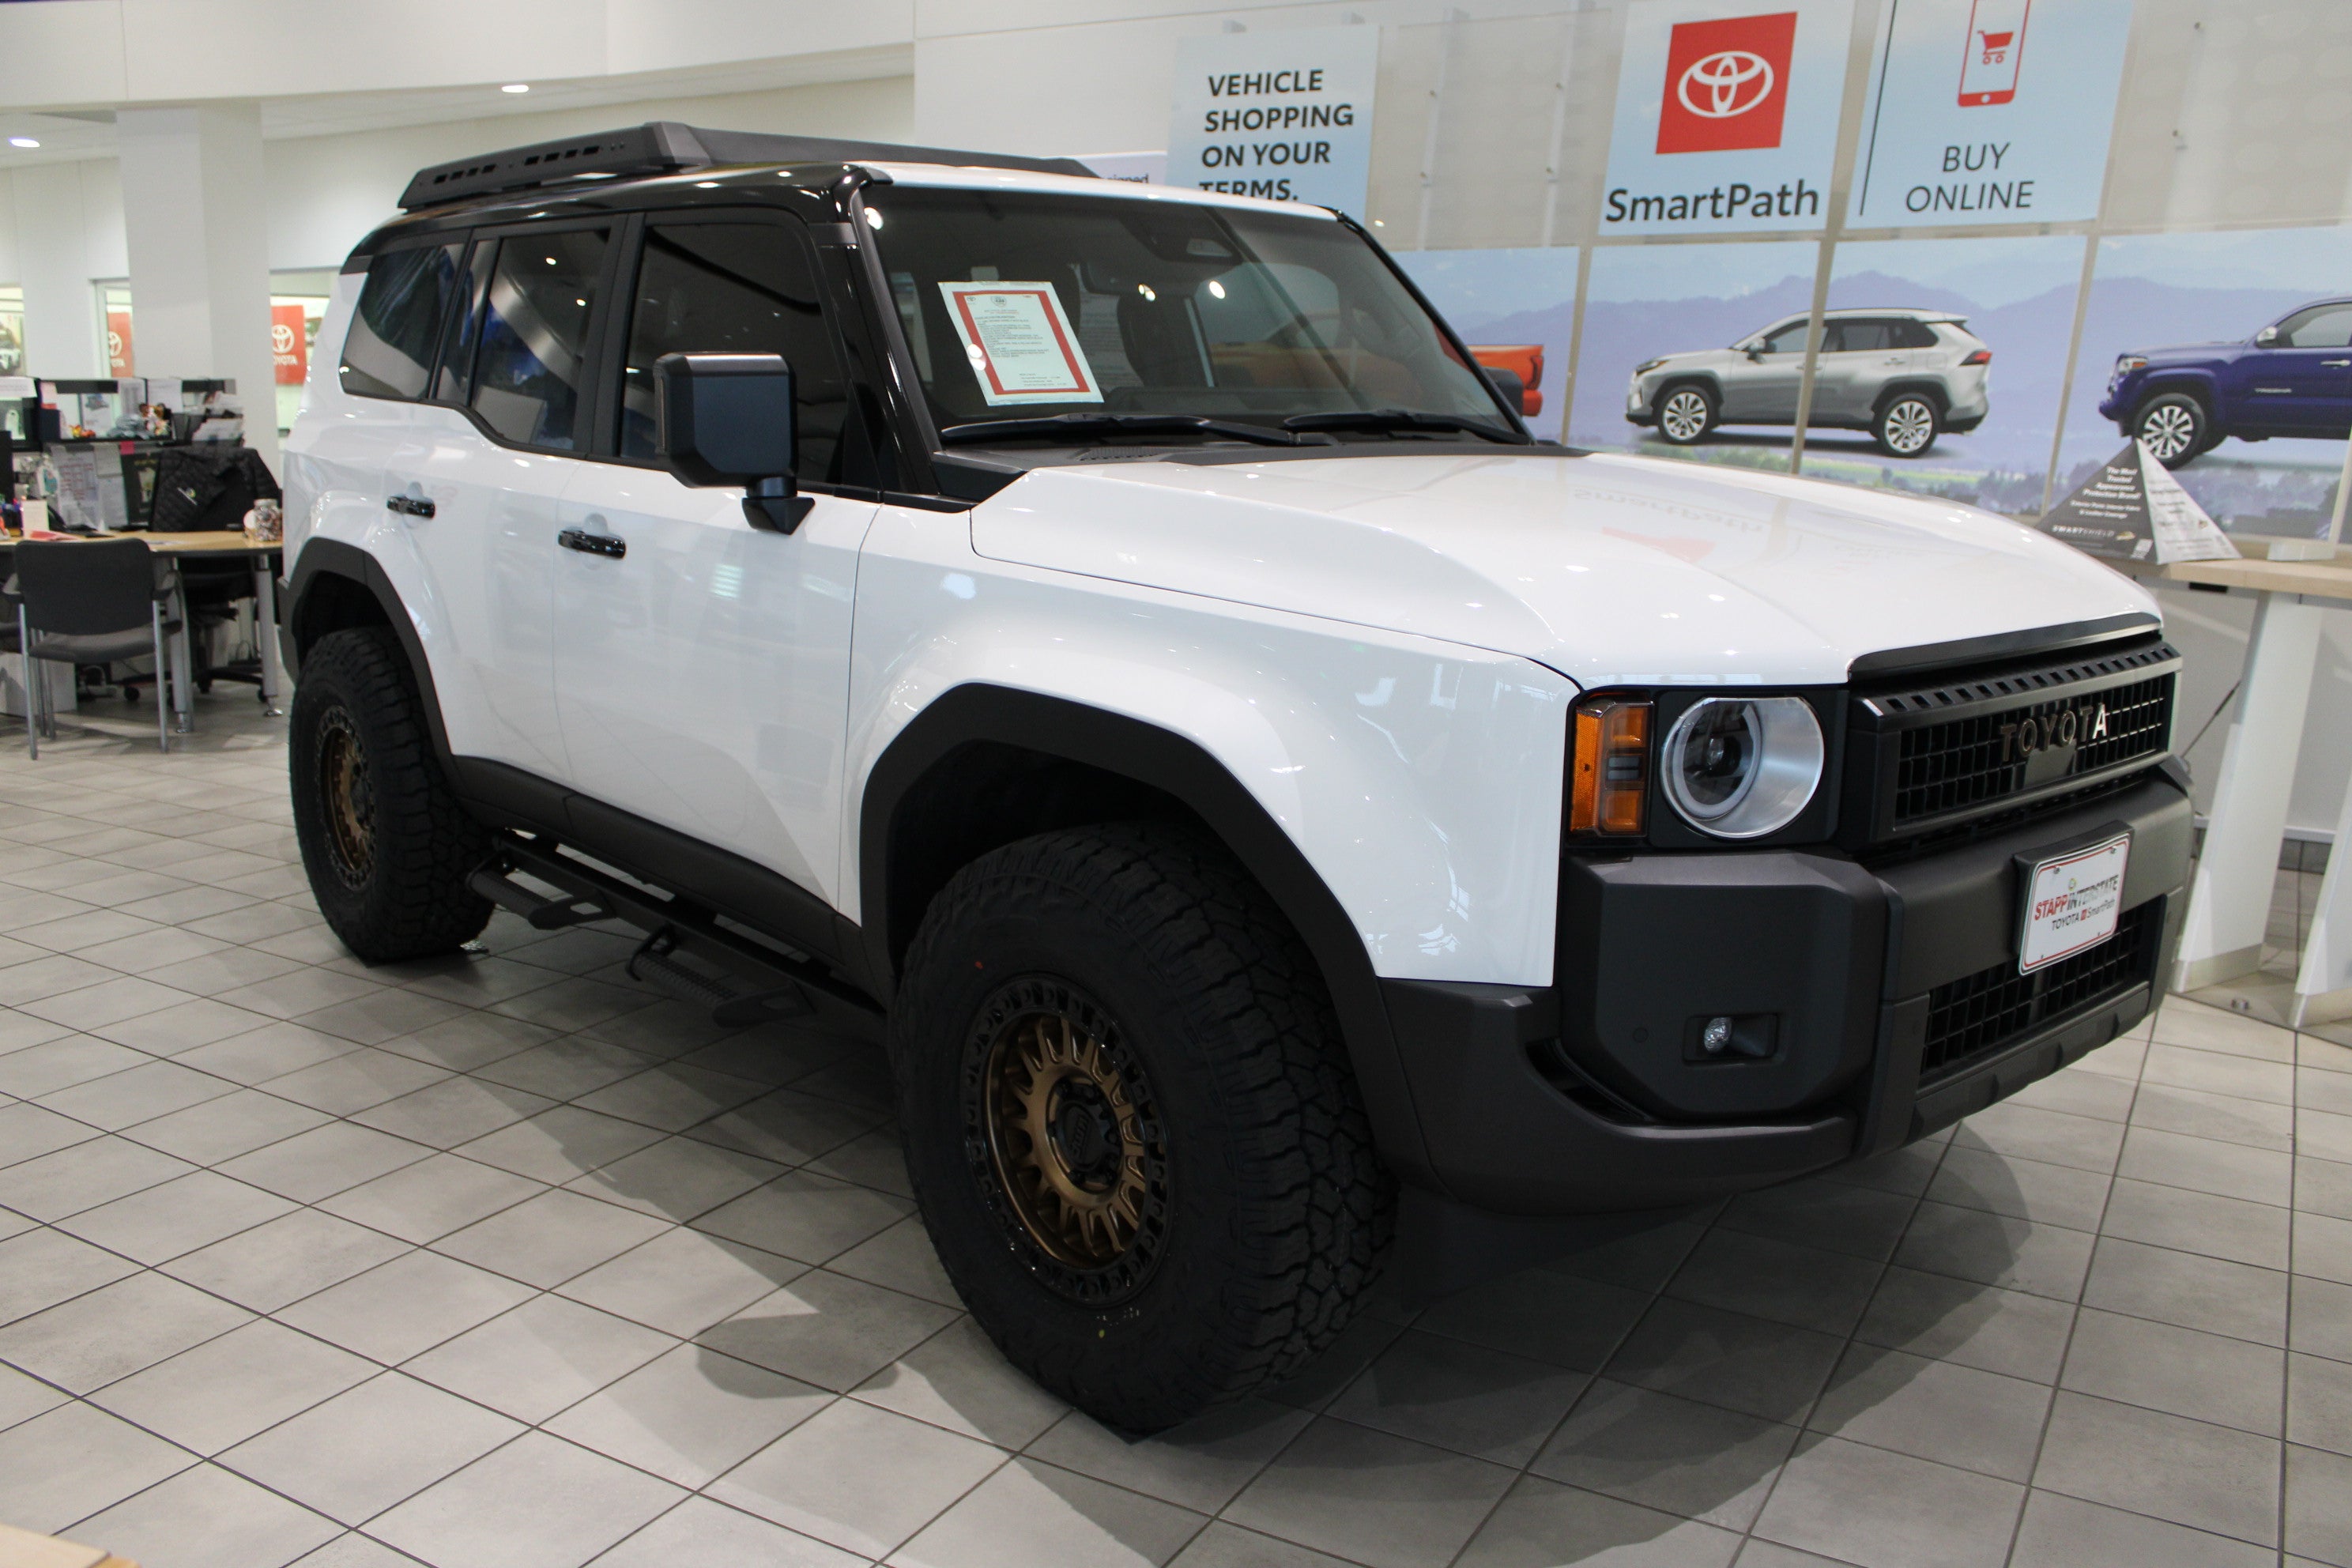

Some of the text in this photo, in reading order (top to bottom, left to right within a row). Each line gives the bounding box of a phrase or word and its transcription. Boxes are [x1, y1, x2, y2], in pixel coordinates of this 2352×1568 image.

[1208, 69, 1324, 96] VEHICLE
[1204, 104, 1354, 133] SHOPPING
[1201, 141, 1332, 168] ON YOUR
[1941, 141, 2011, 173] BUY
[1605, 178, 1819, 222] SmartPath
[1905, 180, 2034, 213] ONLINE
[2000, 702, 2109, 762] TOYOTA
[2052, 912, 2079, 931] TOYOTA
